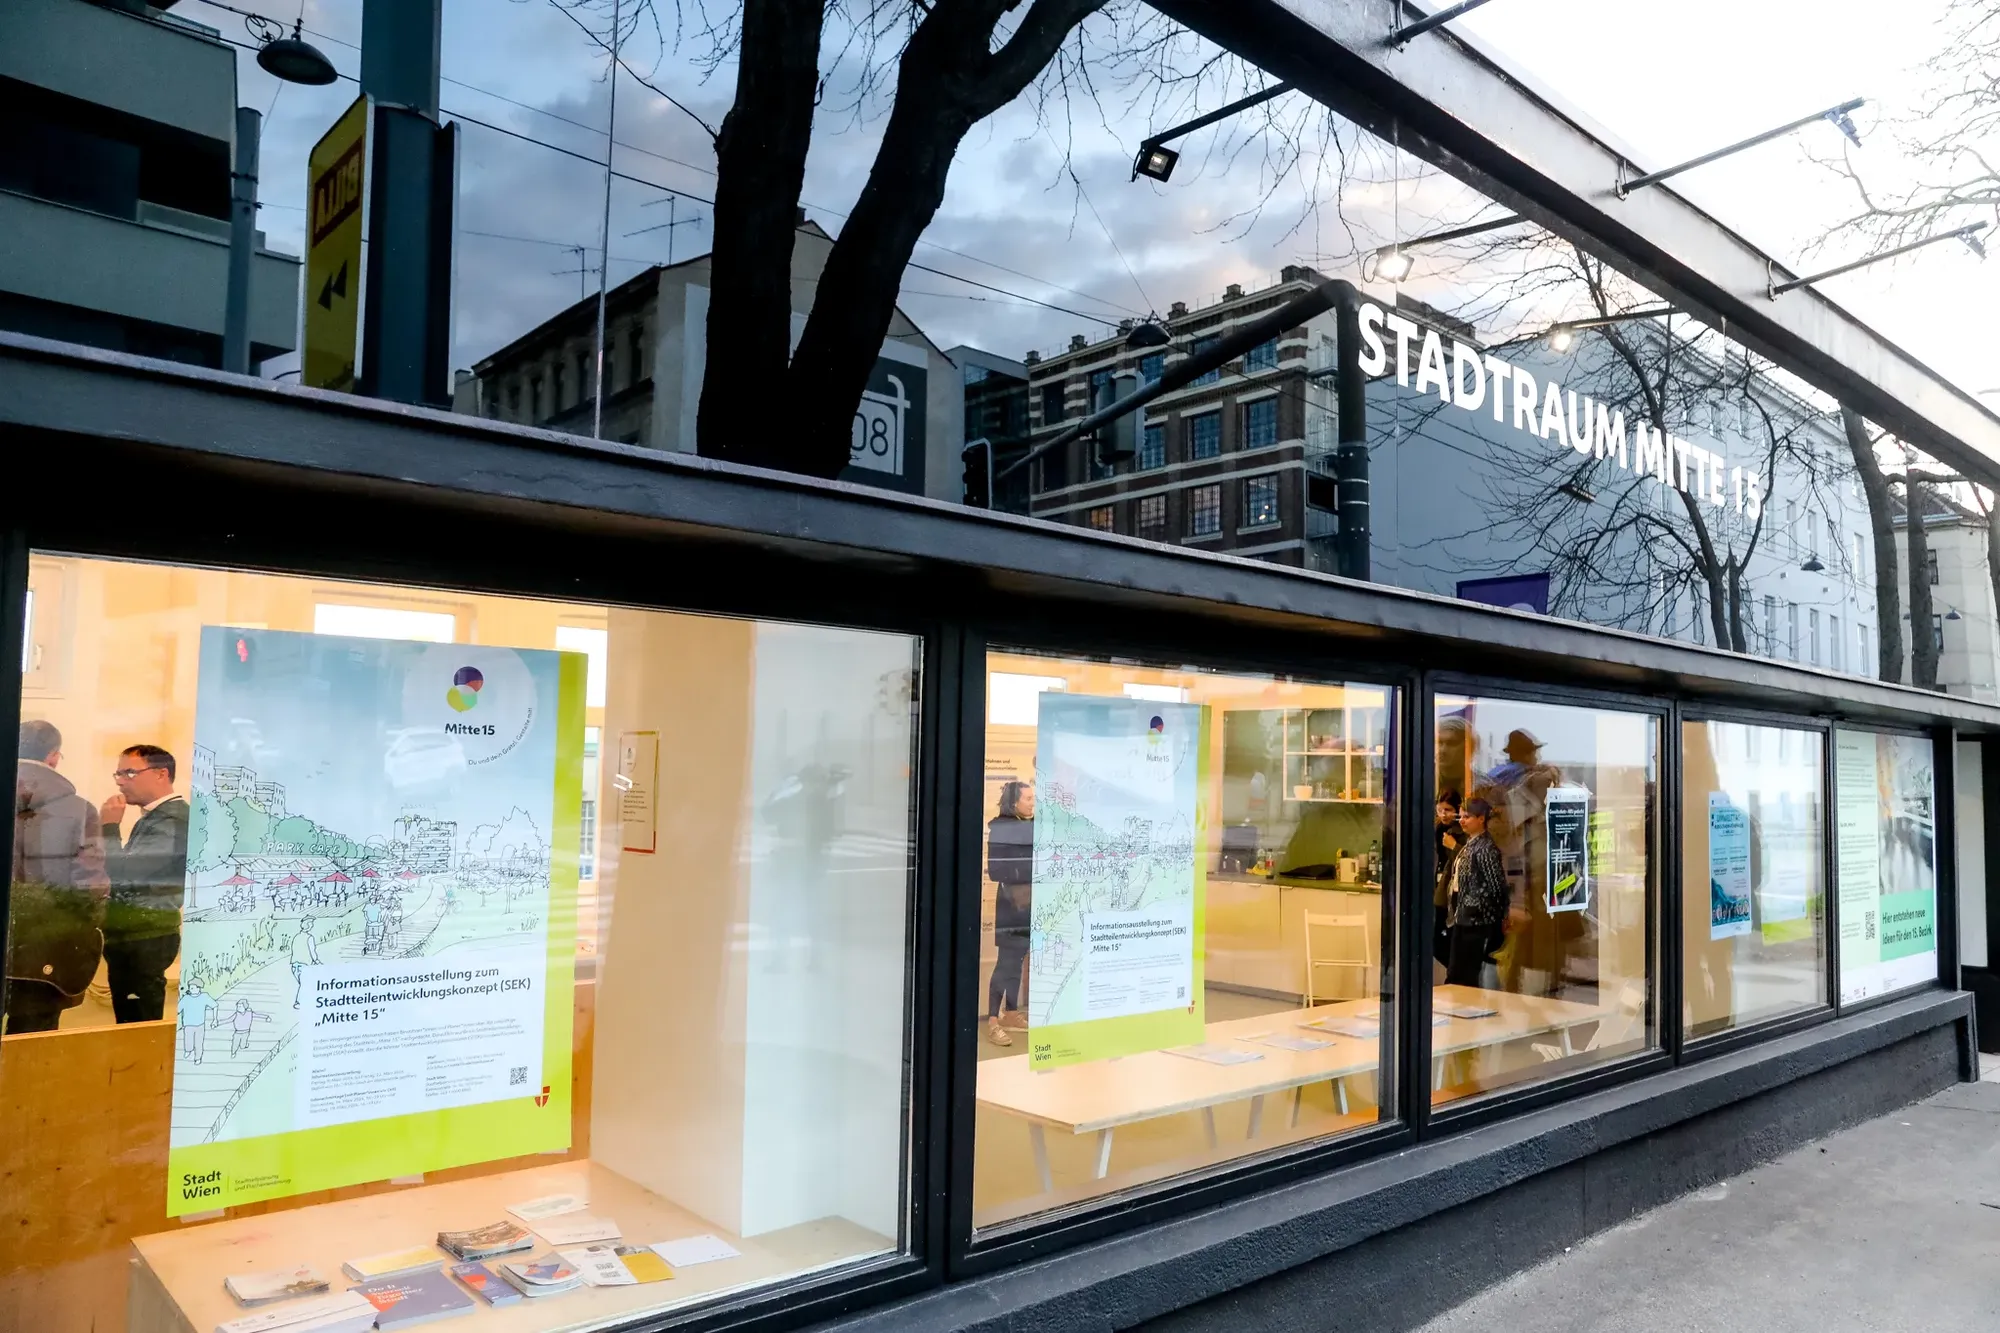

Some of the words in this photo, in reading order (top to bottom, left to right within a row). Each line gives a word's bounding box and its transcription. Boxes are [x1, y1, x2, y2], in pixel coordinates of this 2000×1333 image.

[1358, 302, 1627, 470] STADTRAUM
[1636, 420, 1724, 508] MITTE
[1732, 466, 1762, 520] 15
[1090, 919, 1160, 930] Informationsausstellung
[1090, 930, 1171, 942] Stadtteilentwicklungskonzept
[1172, 927, 1186, 935] (SEK)
[316, 969, 472, 991] Informationsausstellung
[475, 968, 499, 978] zum
[315, 983, 499, 1008] Stadtteilentwicklungskonzept
[500, 977, 531, 992] (SEK)
[1035, 1044, 1051, 1052] Stadt
[1035, 1053, 1051, 1061] Wien
[183, 1171, 221, 1186] Stadt
[183, 1187, 220, 1200] Wien
